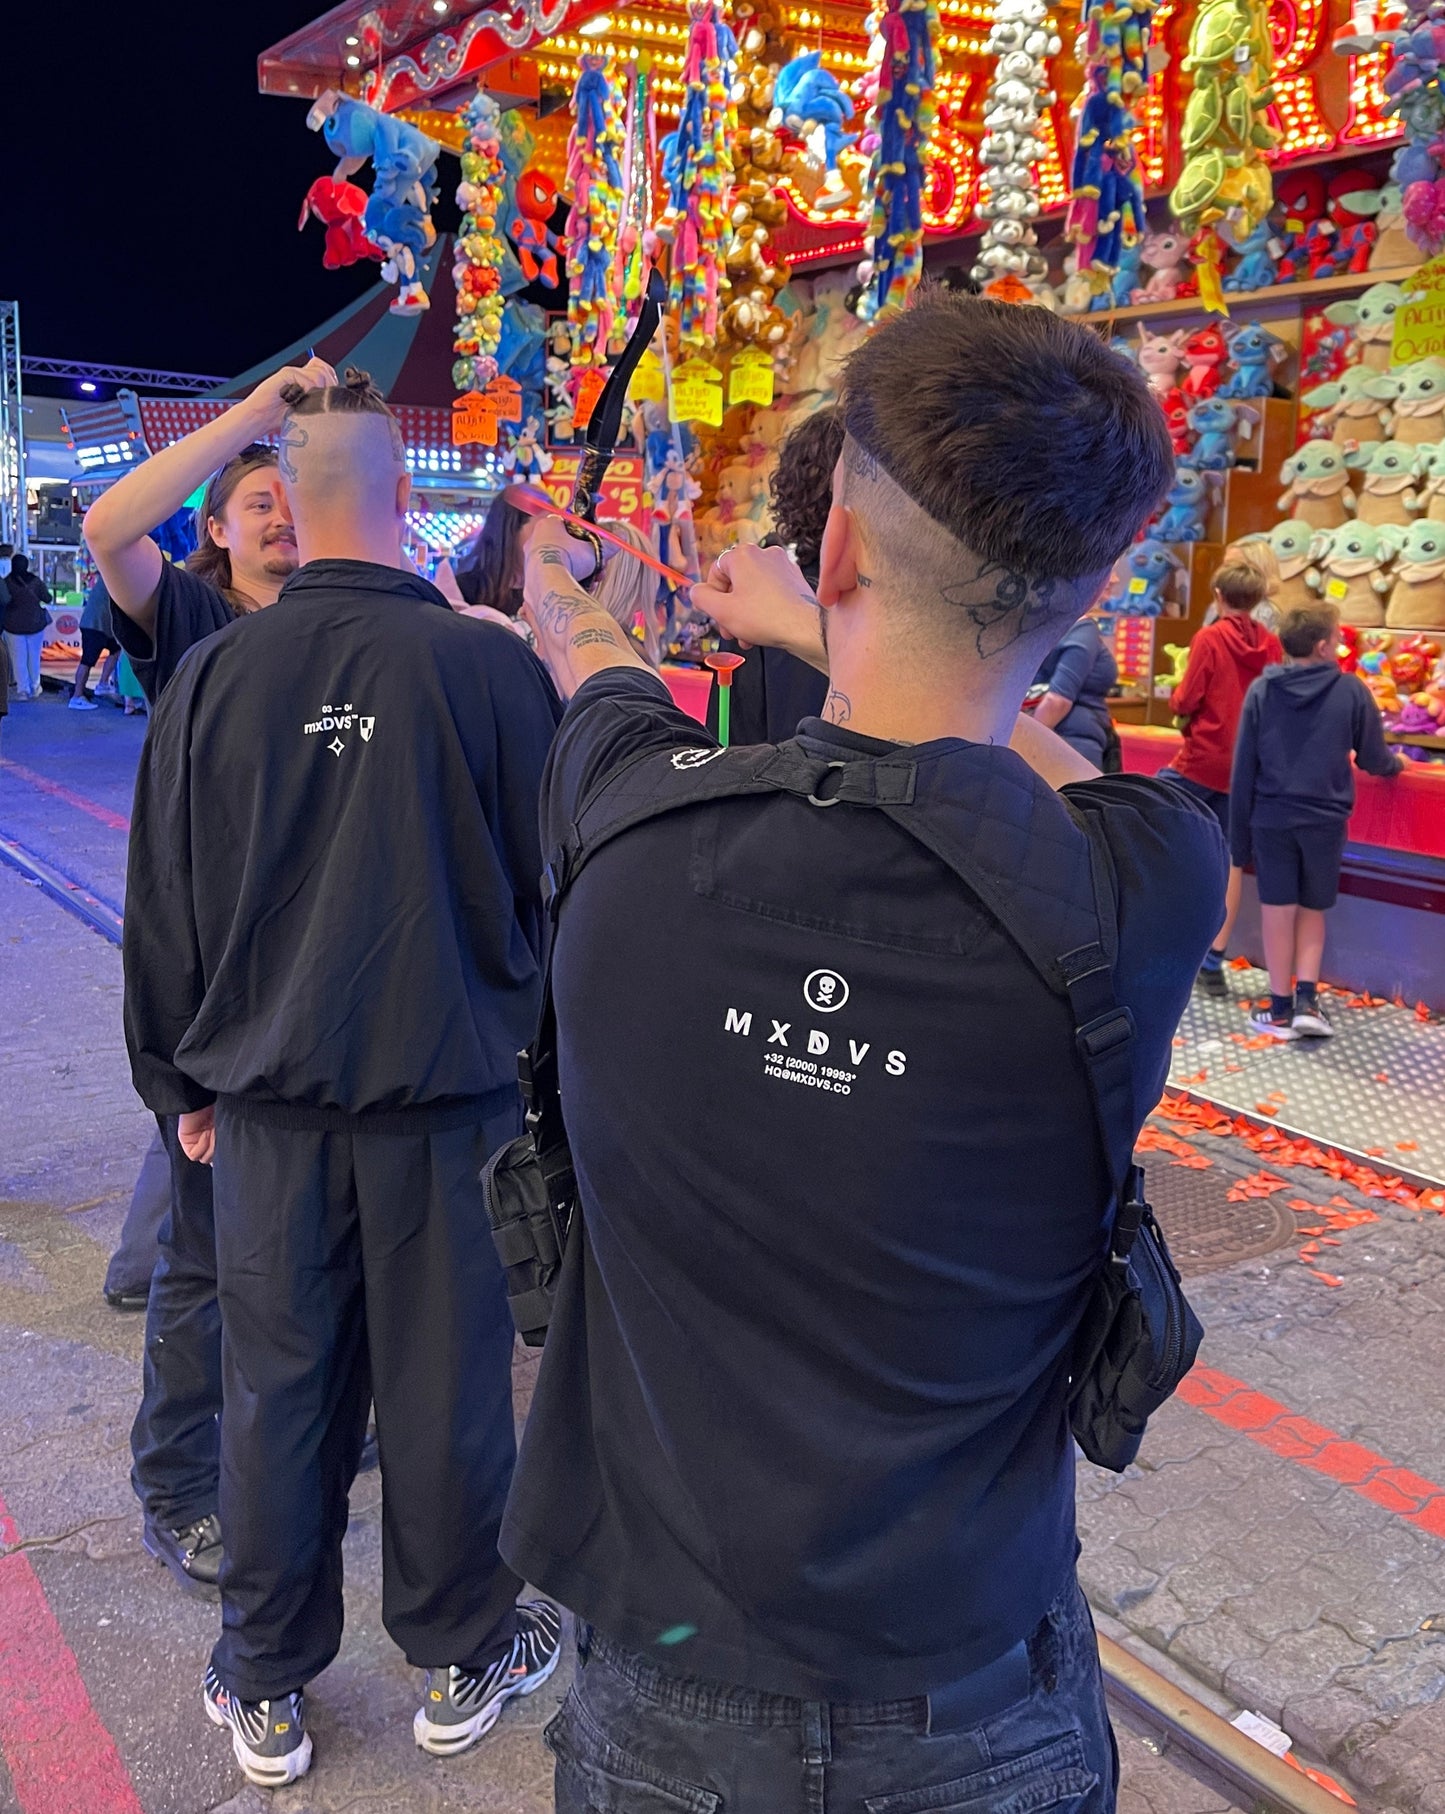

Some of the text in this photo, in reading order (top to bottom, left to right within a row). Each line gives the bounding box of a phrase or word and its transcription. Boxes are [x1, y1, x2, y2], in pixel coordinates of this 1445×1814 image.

[1394, 338, 1445, 361] OCTO
[322, 705, 333, 713] 03
[763, 1053, 784, 1065] +32
[786, 1056, 818, 1075] (2000)
[764, 1065, 851, 1095] HQ@MXDVS.CO
